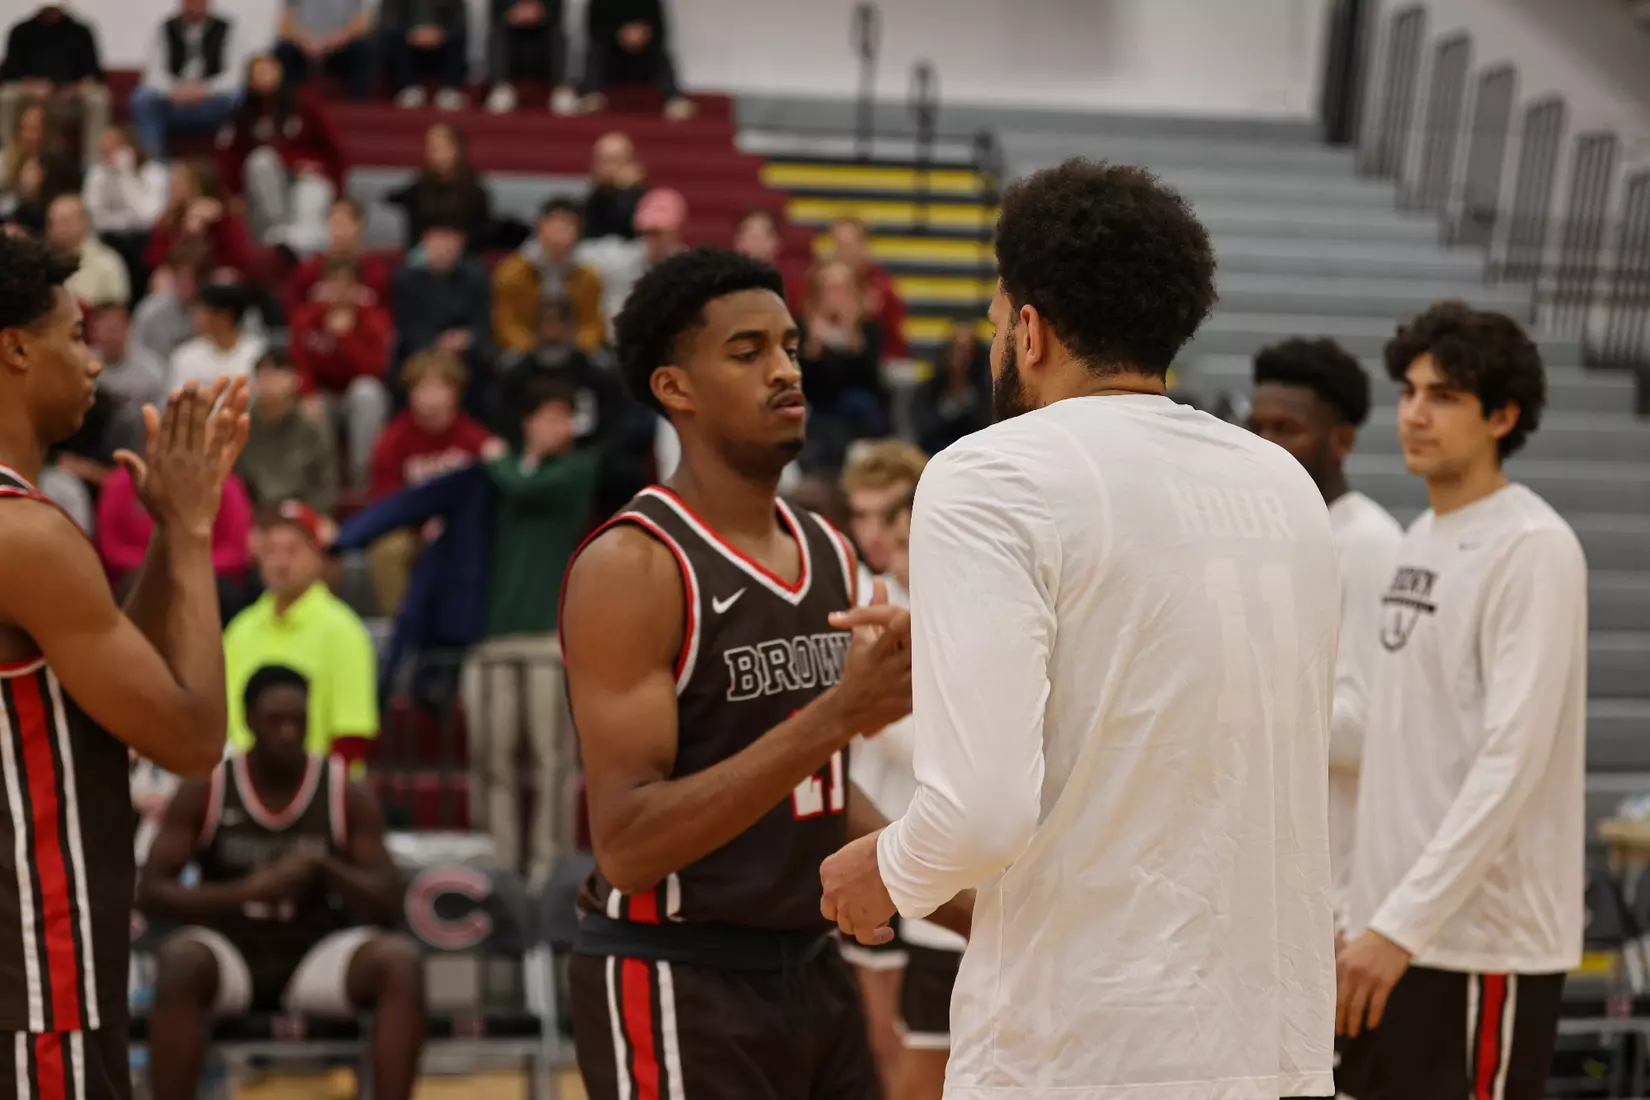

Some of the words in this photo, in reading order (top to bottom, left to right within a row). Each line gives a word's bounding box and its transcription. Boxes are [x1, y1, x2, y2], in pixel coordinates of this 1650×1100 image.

[723, 633, 851, 701] BROW
[1204, 556, 1300, 724] 11
[404, 865, 491, 950] C
